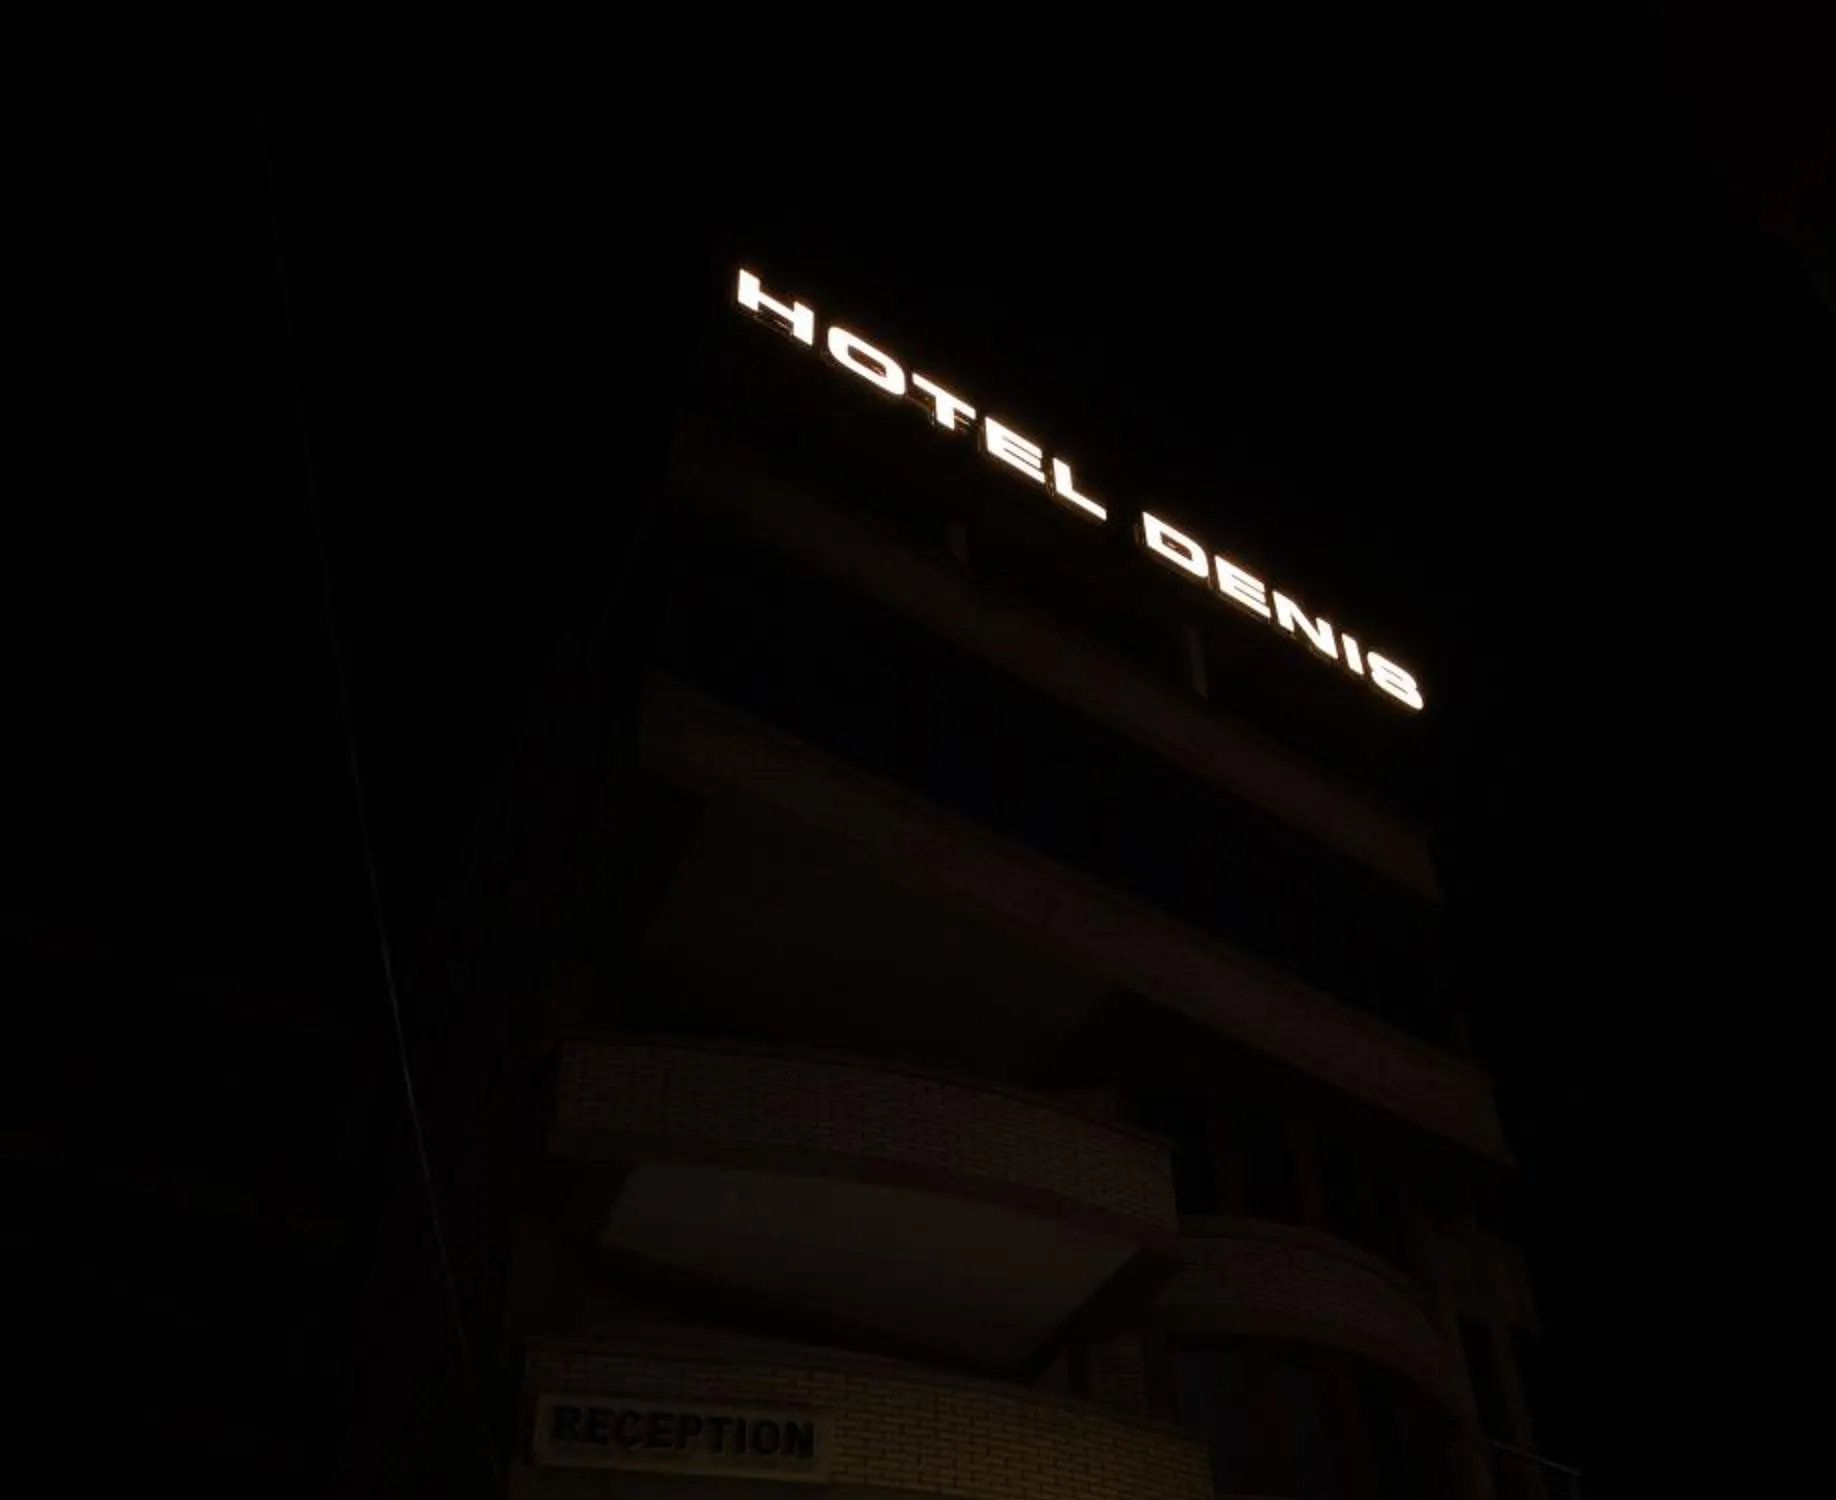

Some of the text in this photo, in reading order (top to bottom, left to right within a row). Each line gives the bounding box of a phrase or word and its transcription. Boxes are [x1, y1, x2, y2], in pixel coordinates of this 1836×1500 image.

[737, 268, 1424, 710] HOTEL DENIS
[552, 1405, 815, 1457] RECEPTION
